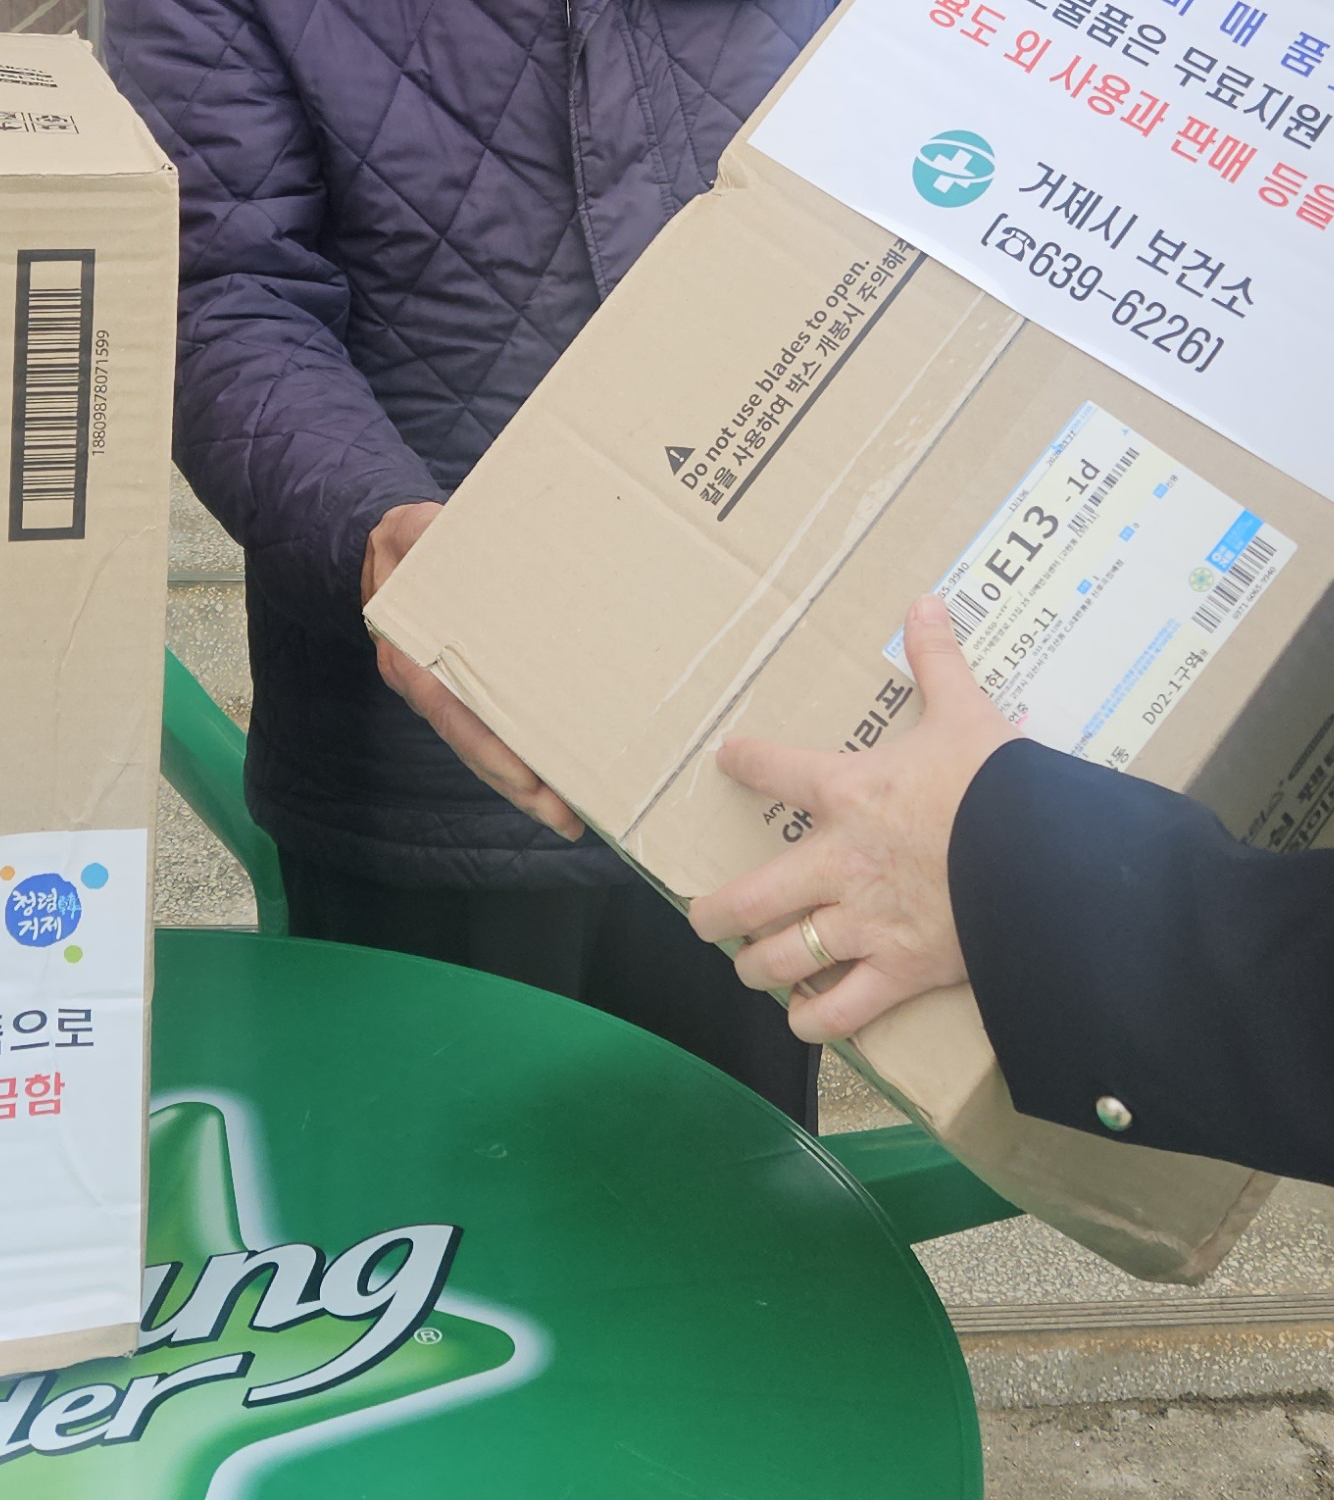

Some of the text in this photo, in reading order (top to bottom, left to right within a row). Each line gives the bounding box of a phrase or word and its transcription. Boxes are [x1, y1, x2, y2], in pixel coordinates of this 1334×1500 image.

[1004, 30, 1052, 73] 외
[1050, 55, 1170, 137] 사용과
[1171, 116, 1257, 183] 판매
[1174, 47, 1333, 149] 무료지원
[1019, 162, 1253, 318] 거제시 보건소
[92, 329, 109, 456] 18809878071599
[681, 261, 869, 489] Do not use blades to open.
[700, 467, 737, 506] 칼을
[733, 394, 793, 466] 사용하여
[785, 361, 822, 393] 박스
[816, 303, 865, 357] 개봉시
[1001, 603, 1058, 671] 159-11
[18, 916, 62, 941] 거제
